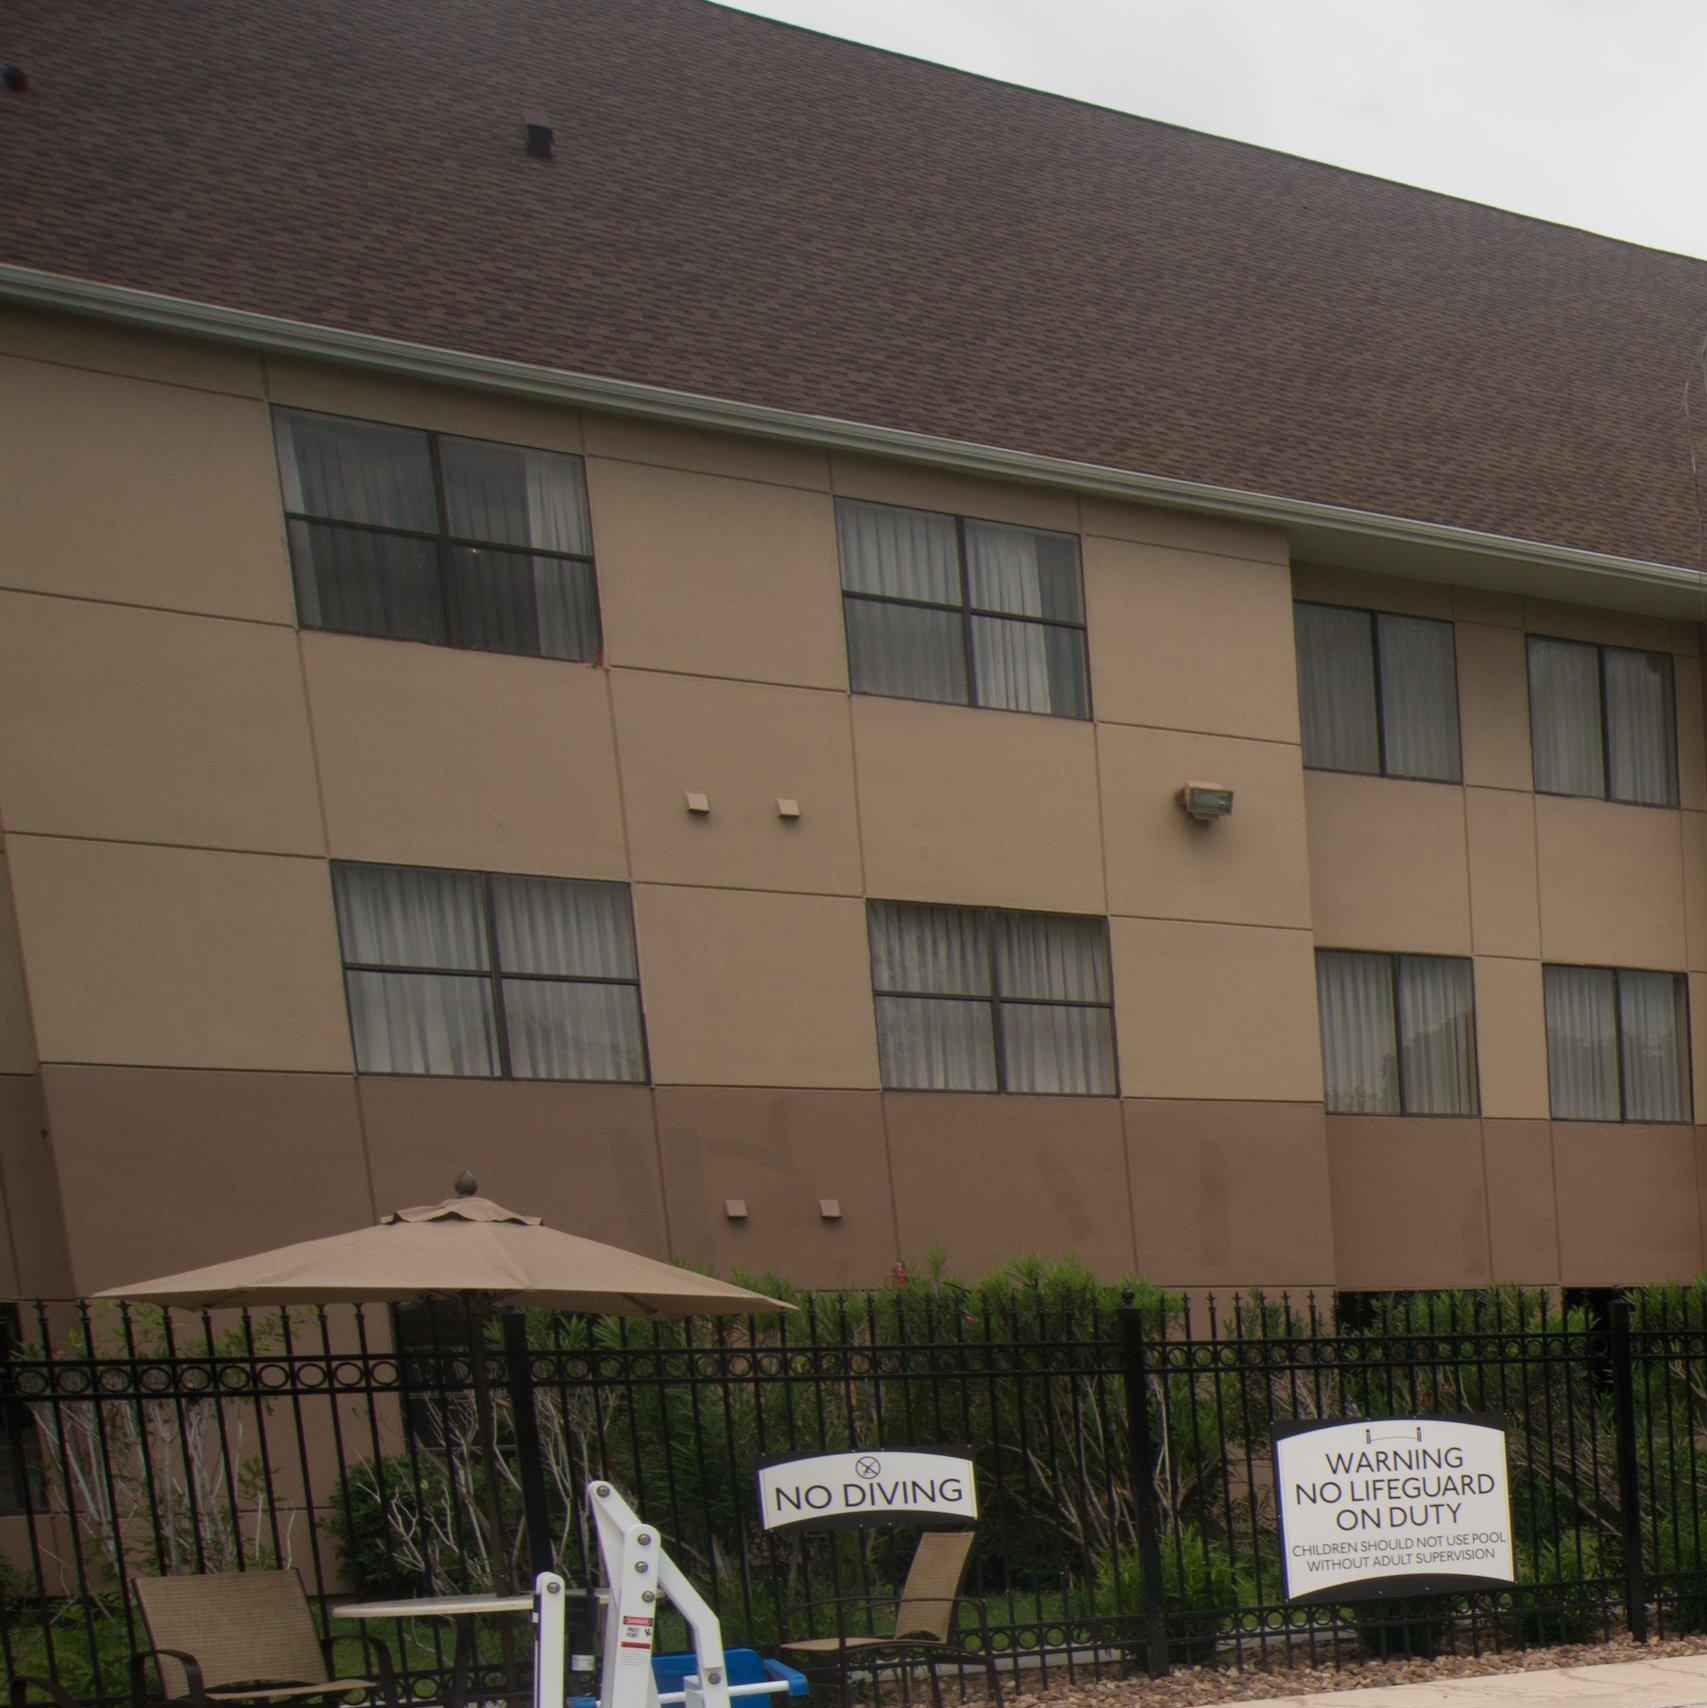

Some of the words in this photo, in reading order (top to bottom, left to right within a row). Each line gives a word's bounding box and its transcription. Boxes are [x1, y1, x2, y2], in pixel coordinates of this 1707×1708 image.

[1326, 1447, 1464, 1475] WARNING
[775, 1484, 833, 1512] NO
[843, 1478, 963, 1508] DIVING
[1296, 1482, 1342, 1505] NO
[1350, 1474, 1495, 1502] LIFEGUARD
[1336, 1507, 1381, 1531] ON
[1389, 1502, 1463, 1528] DUTY
[1292, 1542, 1358, 1557] CHILDREN
[1361, 1538, 1413, 1553] SHOULD
[1417, 1535, 1443, 1548] NOT
[1446, 1533, 1470, 1546] USE
[1472, 1531, 1506, 1545] POOL
[1306, 1557, 1369, 1572] WITHOUT
[1373, 1553, 1412, 1567] ADULT
[1416, 1548, 1495, 1564] SUPERVISION
